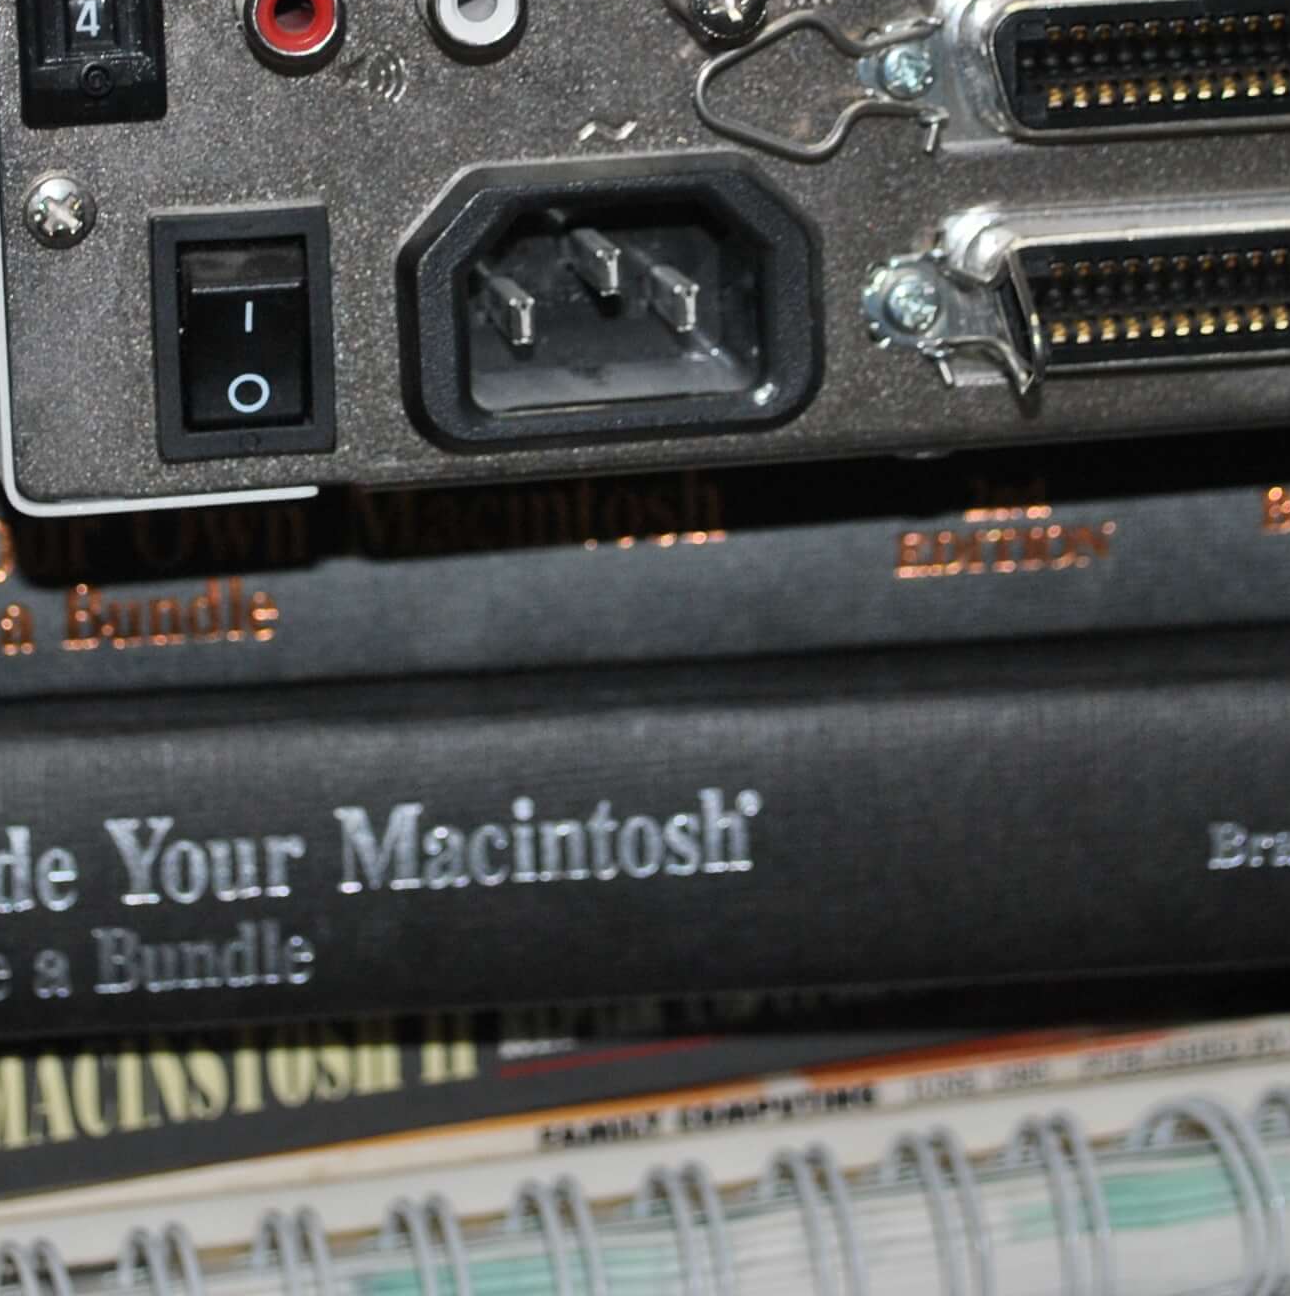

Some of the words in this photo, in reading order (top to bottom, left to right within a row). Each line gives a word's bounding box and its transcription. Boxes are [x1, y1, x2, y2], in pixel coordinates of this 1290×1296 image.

[0, 602, 34, 656] a
[62, 577, 280, 653] Bundle
[105, 815, 306, 906] Your
[33, 949, 73, 999] a
[92, 920, 315, 996] Bundle
